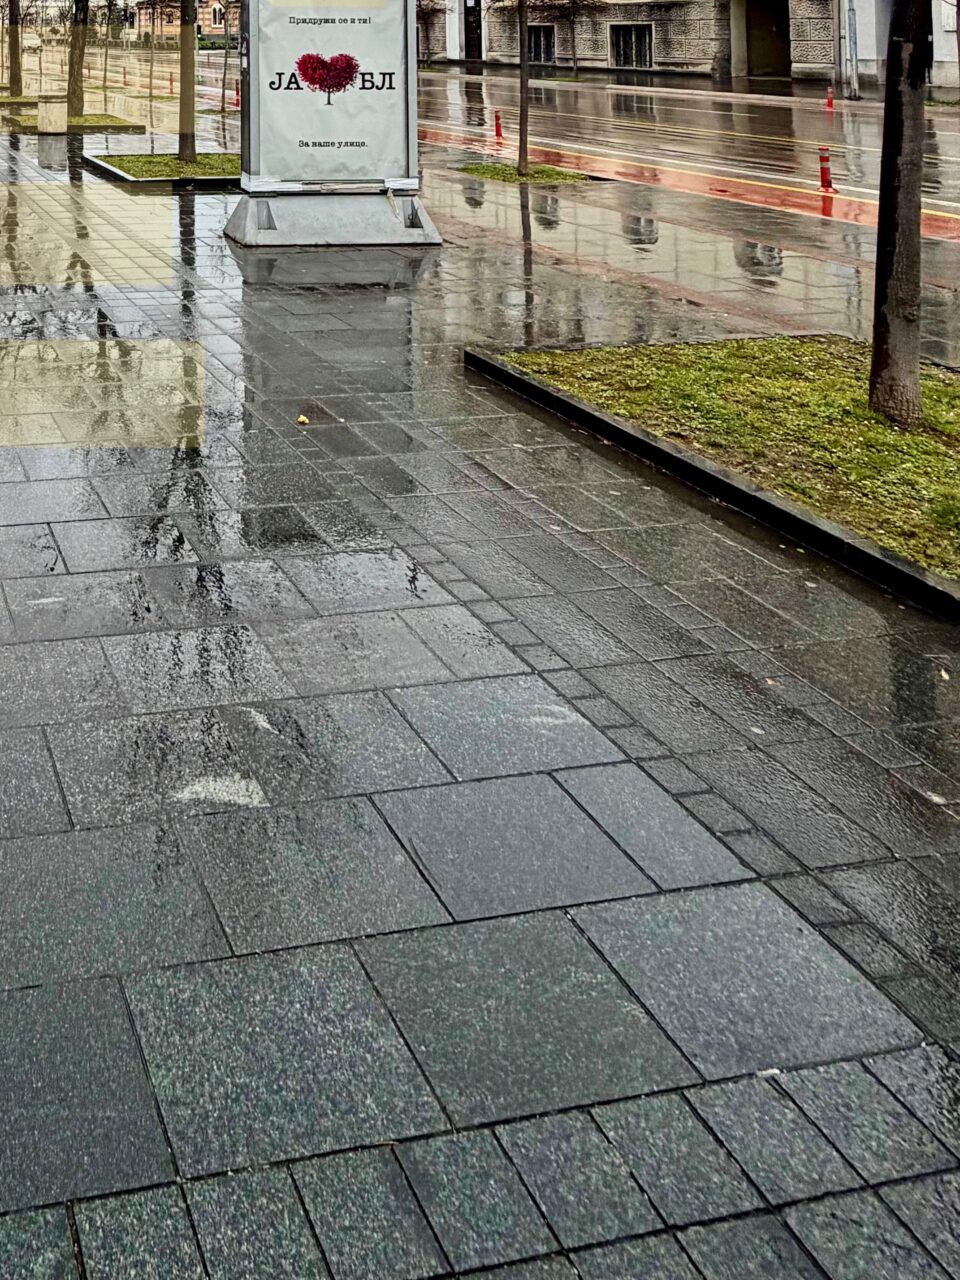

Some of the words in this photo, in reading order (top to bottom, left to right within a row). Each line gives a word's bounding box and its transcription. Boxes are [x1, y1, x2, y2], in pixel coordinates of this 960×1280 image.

[288, 16, 337, 26] Придружи
[268, 72, 304, 91] ЈА
[358, 72, 396, 91] БЛ
[298, 139, 310, 148] За
